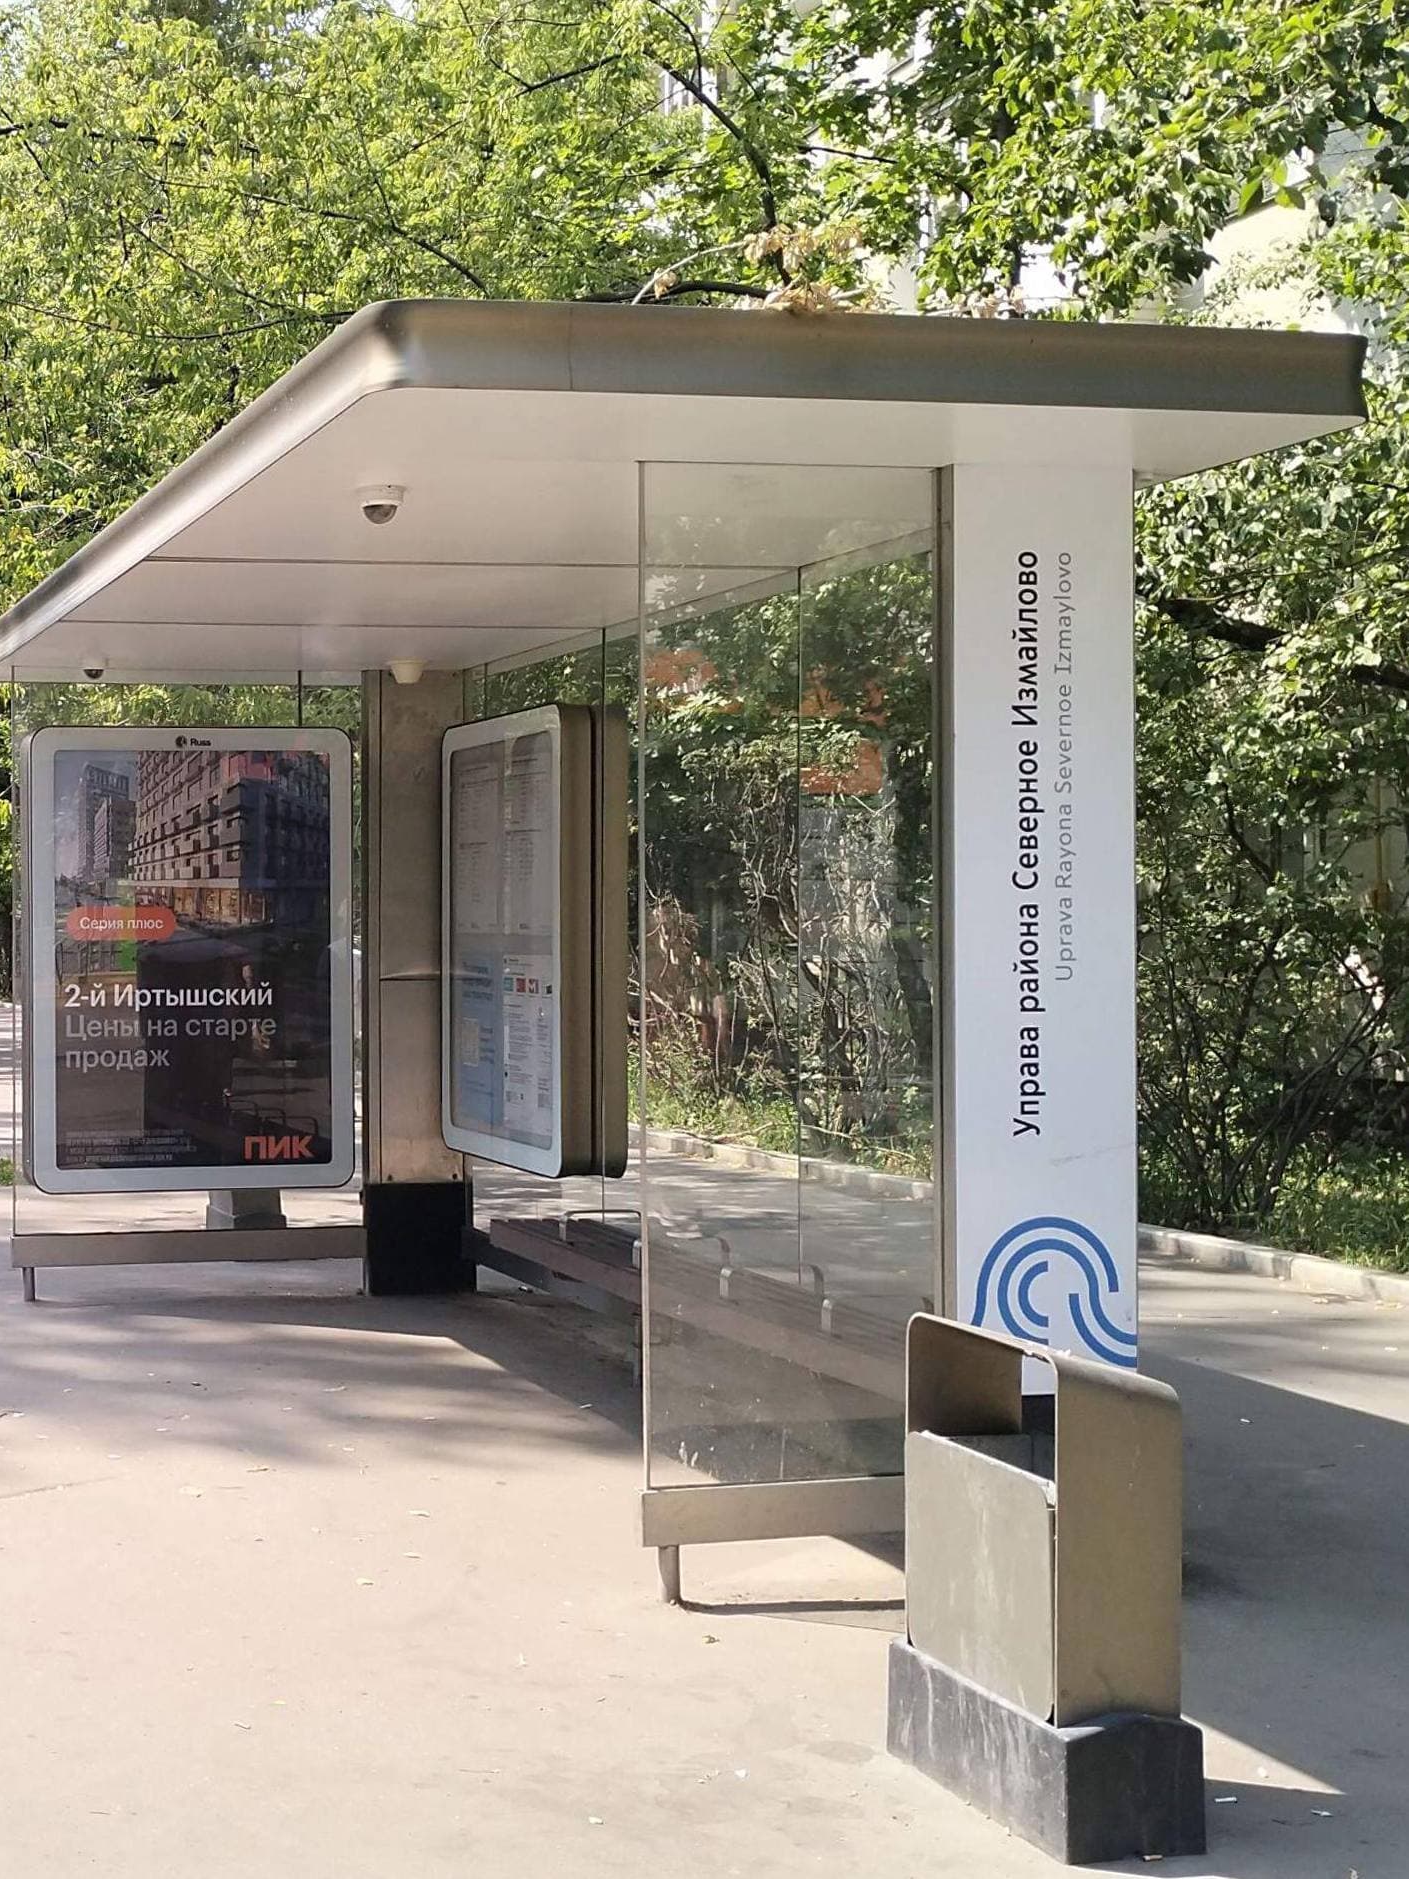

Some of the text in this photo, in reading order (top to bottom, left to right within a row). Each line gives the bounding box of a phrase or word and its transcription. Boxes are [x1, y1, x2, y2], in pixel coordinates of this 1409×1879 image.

[1052, 551, 1077, 981] Uprava Rayona Severnoe Izmaylovo
[1011, 551, 1046, 1137] Управа района Северное Измайлово
[79, 916, 164, 932] Серия плюс
[63, 982, 273, 1011] 2-й Иртышский
[65, 1015, 277, 1041] Цены на старте
[65, 1048, 170, 1073] продаж
[243, 1135, 316, 1160] ПИК
